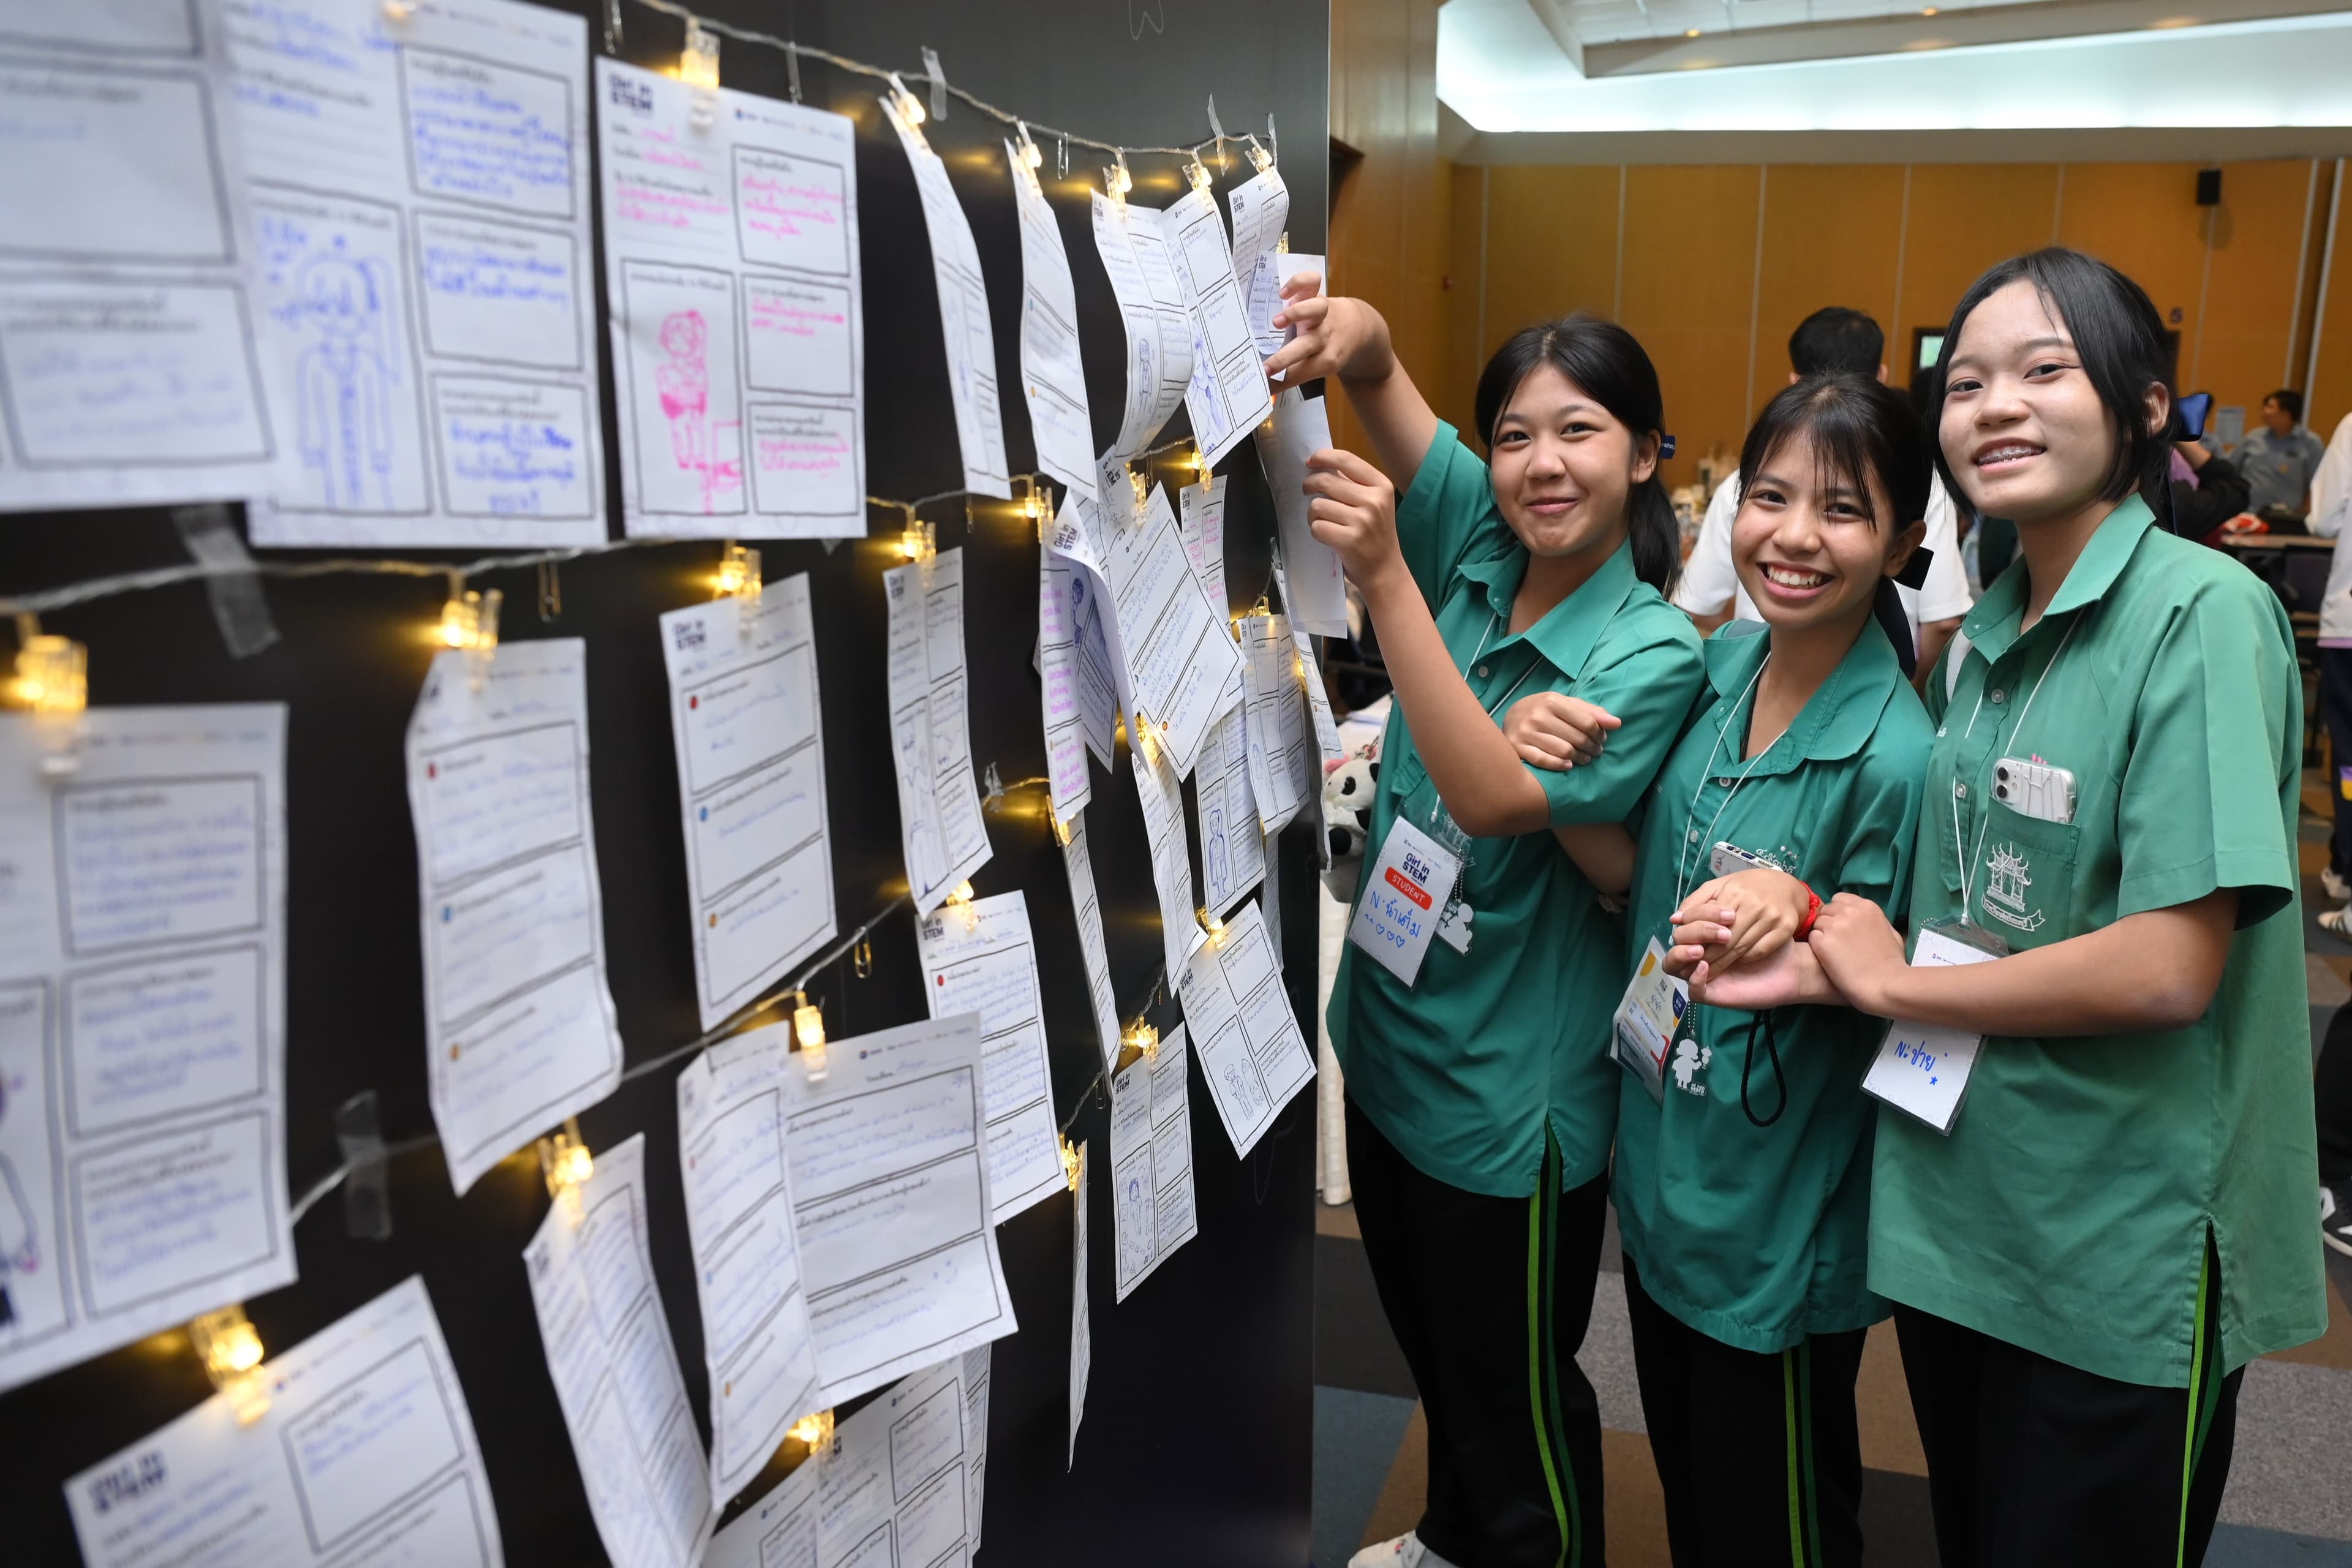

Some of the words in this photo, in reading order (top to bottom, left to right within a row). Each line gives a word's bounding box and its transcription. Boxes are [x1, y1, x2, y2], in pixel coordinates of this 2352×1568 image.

[1234, 200, 1245, 213] STEM
[1103, 461, 1117, 486] SEM
[1060, 524, 1070, 532] in
[1054, 532, 1067, 548] Girl
[1063, 527, 1079, 551] STEM
[1402, 861, 1428, 884] STEM
[1406, 852, 1421, 869] Girl
[1422, 862, 1430, 876] in
[1392, 874, 1426, 903] STUDENT
[1181, 973, 1193, 991] STEM
[1116, 1079, 1131, 1095] STEM
[1117, 1076, 1125, 1088] Girl
[1125, 1072, 1131, 1081] in
